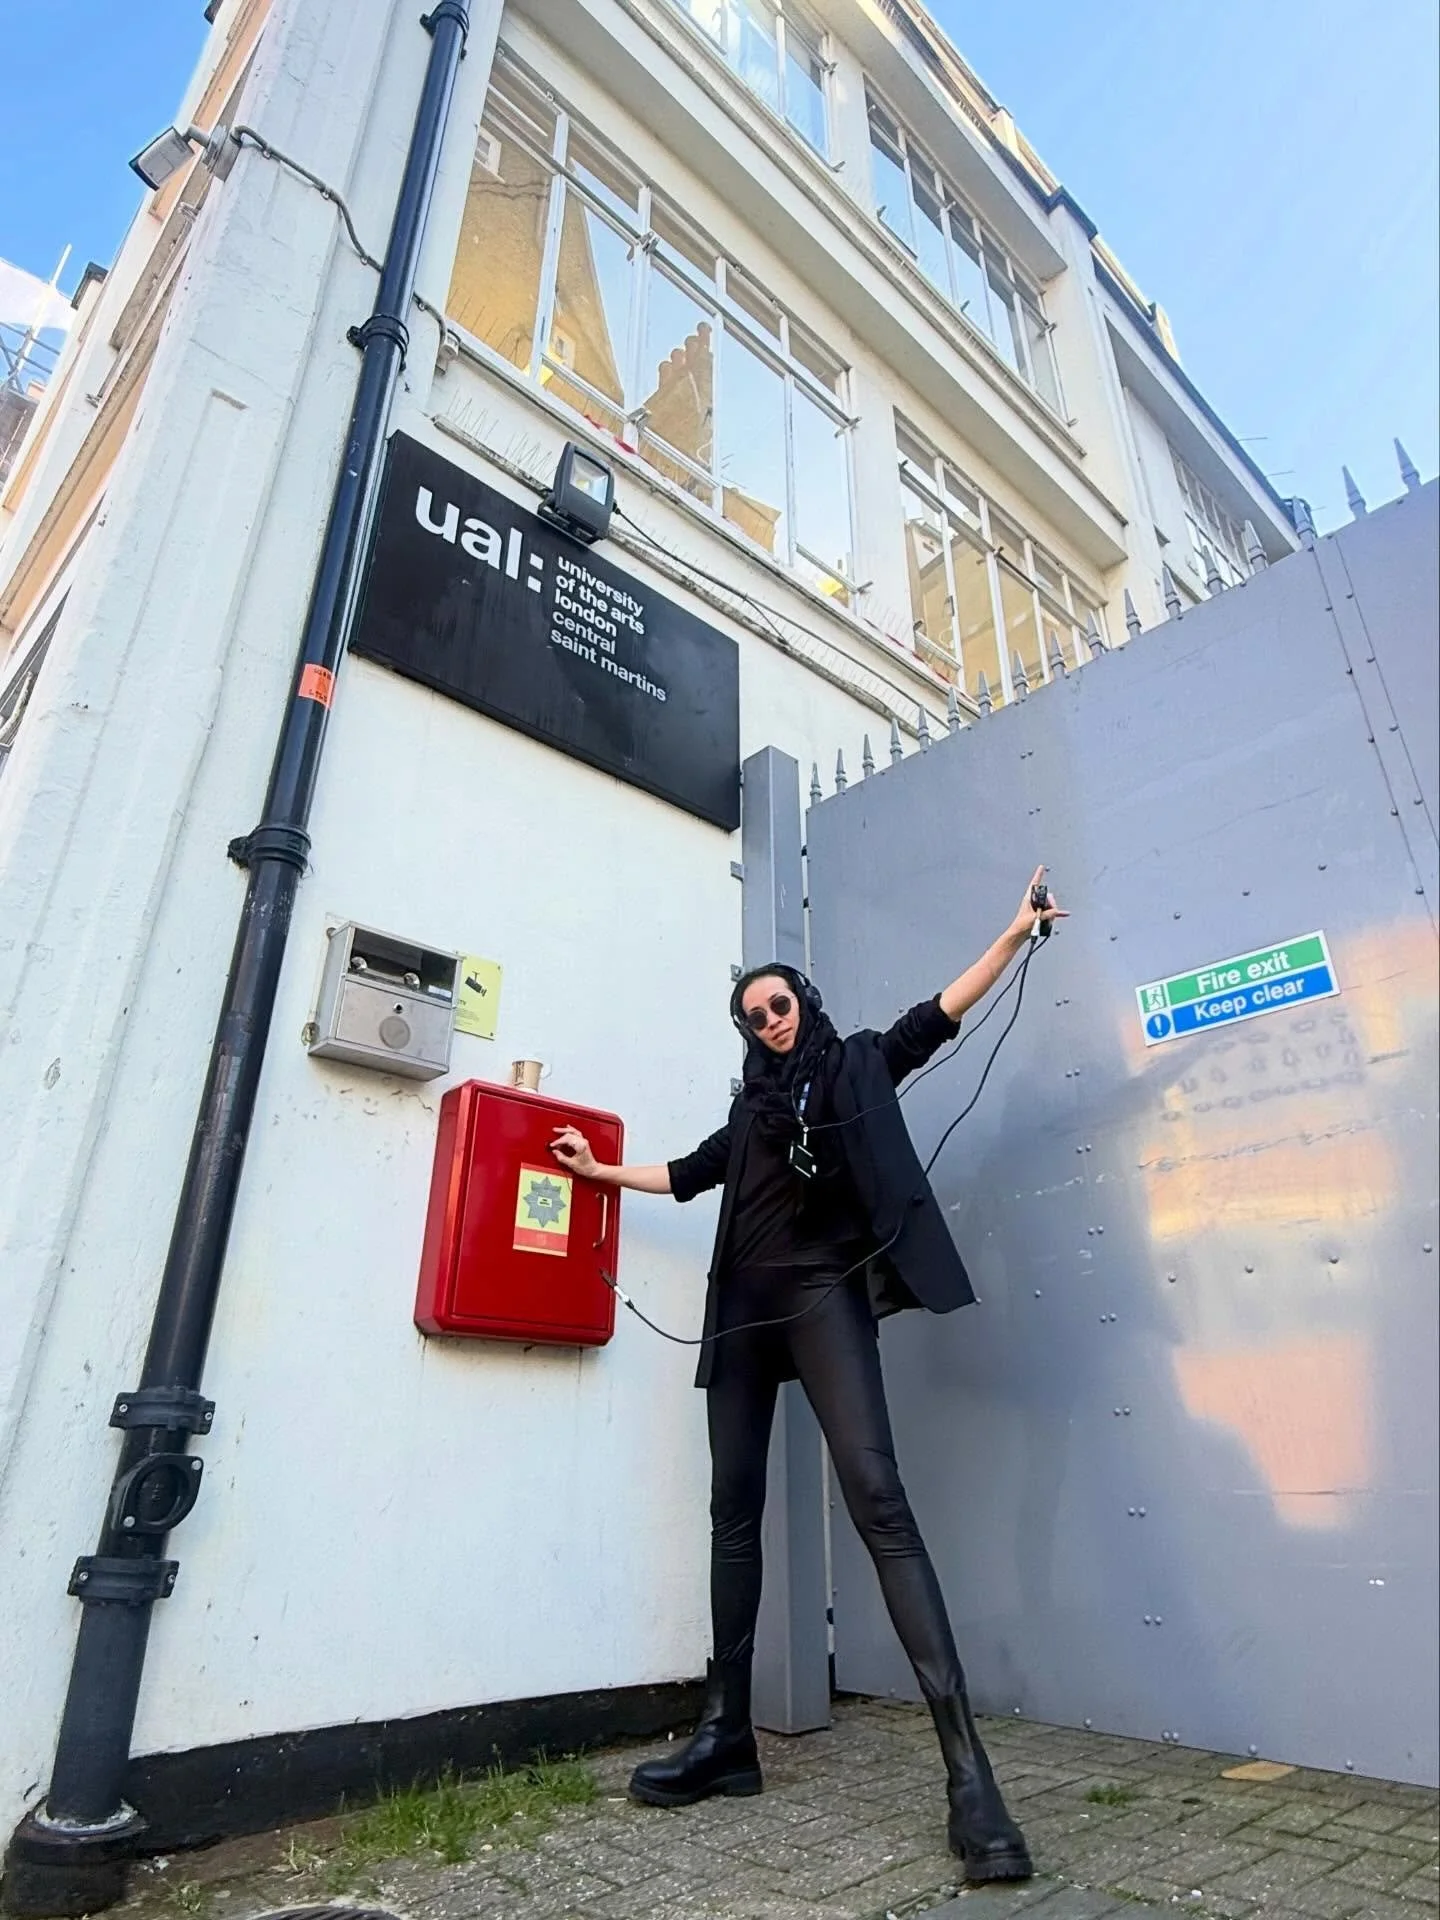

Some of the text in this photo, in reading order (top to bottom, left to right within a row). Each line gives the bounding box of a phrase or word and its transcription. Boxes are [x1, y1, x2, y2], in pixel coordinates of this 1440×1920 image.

[416, 486, 543, 593] ual:
[554, 588, 617, 637] london
[556, 574, 646, 635] of the arts
[557, 555, 645, 618] university
[552, 611, 616, 655] central
[550, 629, 667, 702] saint martins
[1193, 978, 1305, 1021] Keep clear
[1196, 951, 1291, 994] Fire exit
